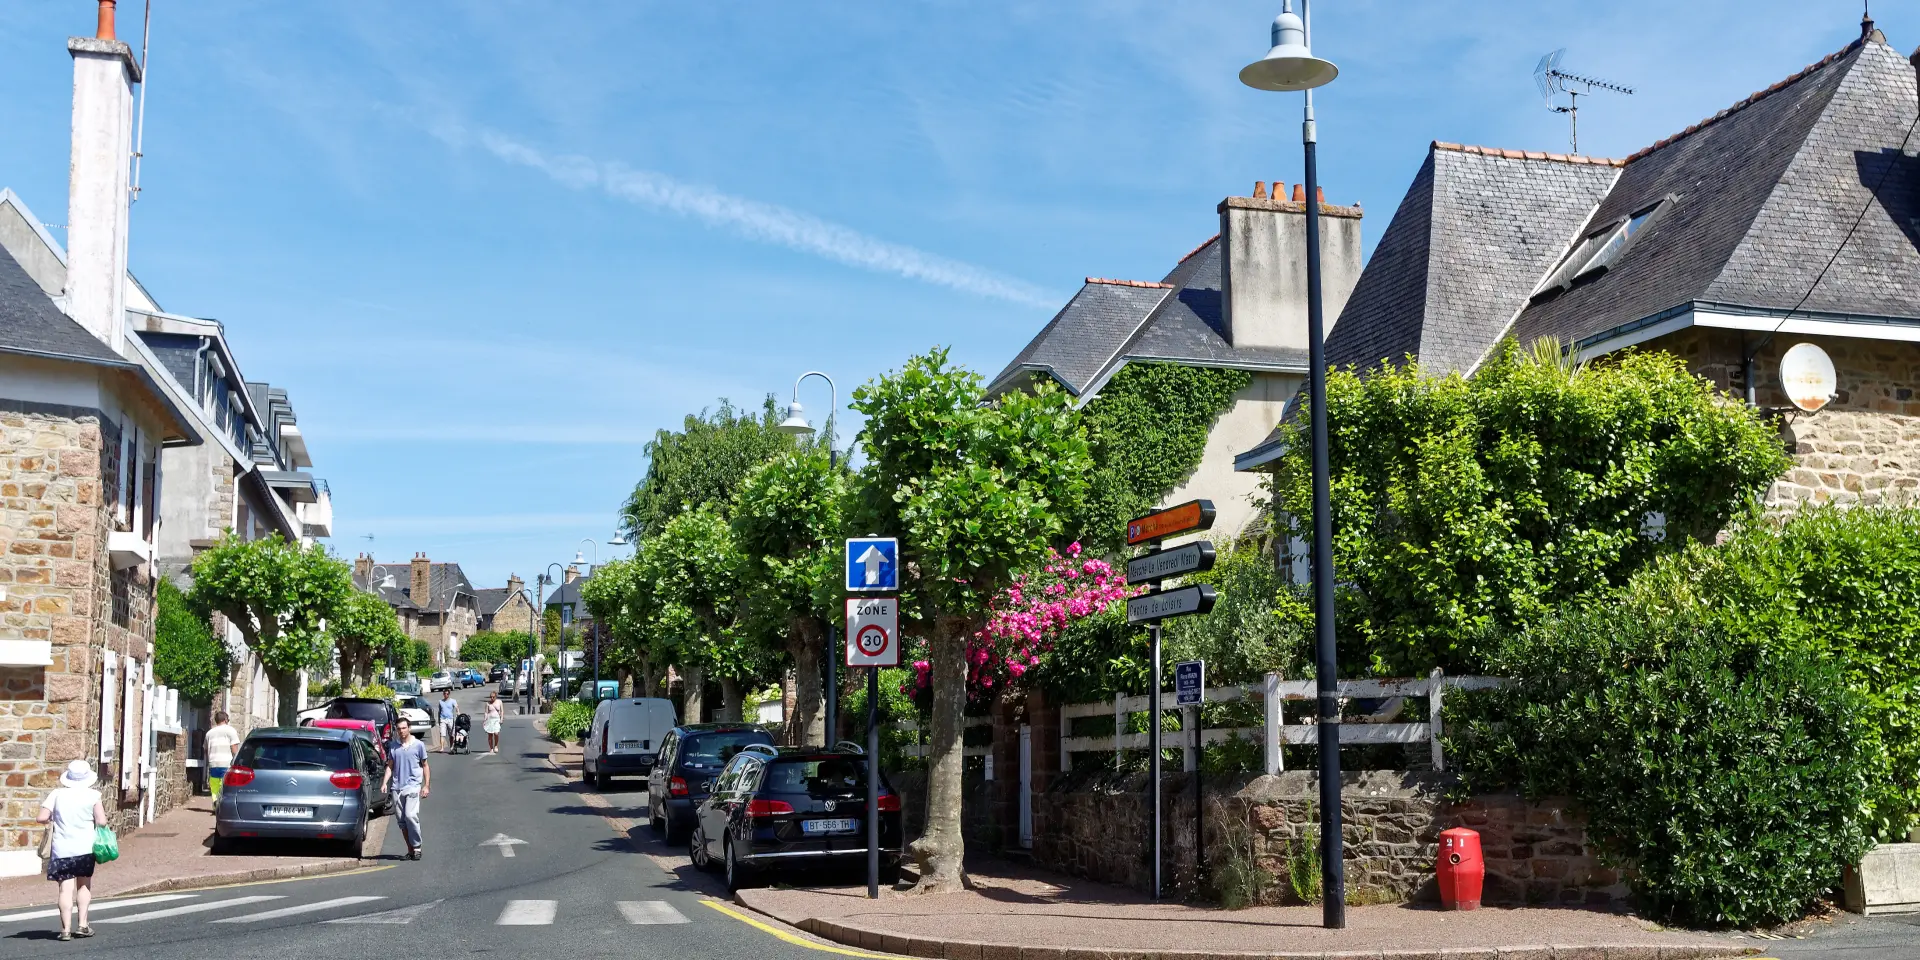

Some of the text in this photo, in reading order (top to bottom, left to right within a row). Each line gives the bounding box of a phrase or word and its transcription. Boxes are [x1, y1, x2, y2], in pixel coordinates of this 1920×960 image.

[1130, 563, 1147, 577] Marché
[1156, 555, 1179, 571] Vendredi
[1181, 552, 1197, 566] Matin
[856, 606, 888, 616] ZONE
[1129, 596, 1182, 617] Centre de Loisirs
[864, 635, 882, 647] 30
[809, 820, 850, 830] BT-556-TH
[1446, 838, 1464, 847] 2 1
